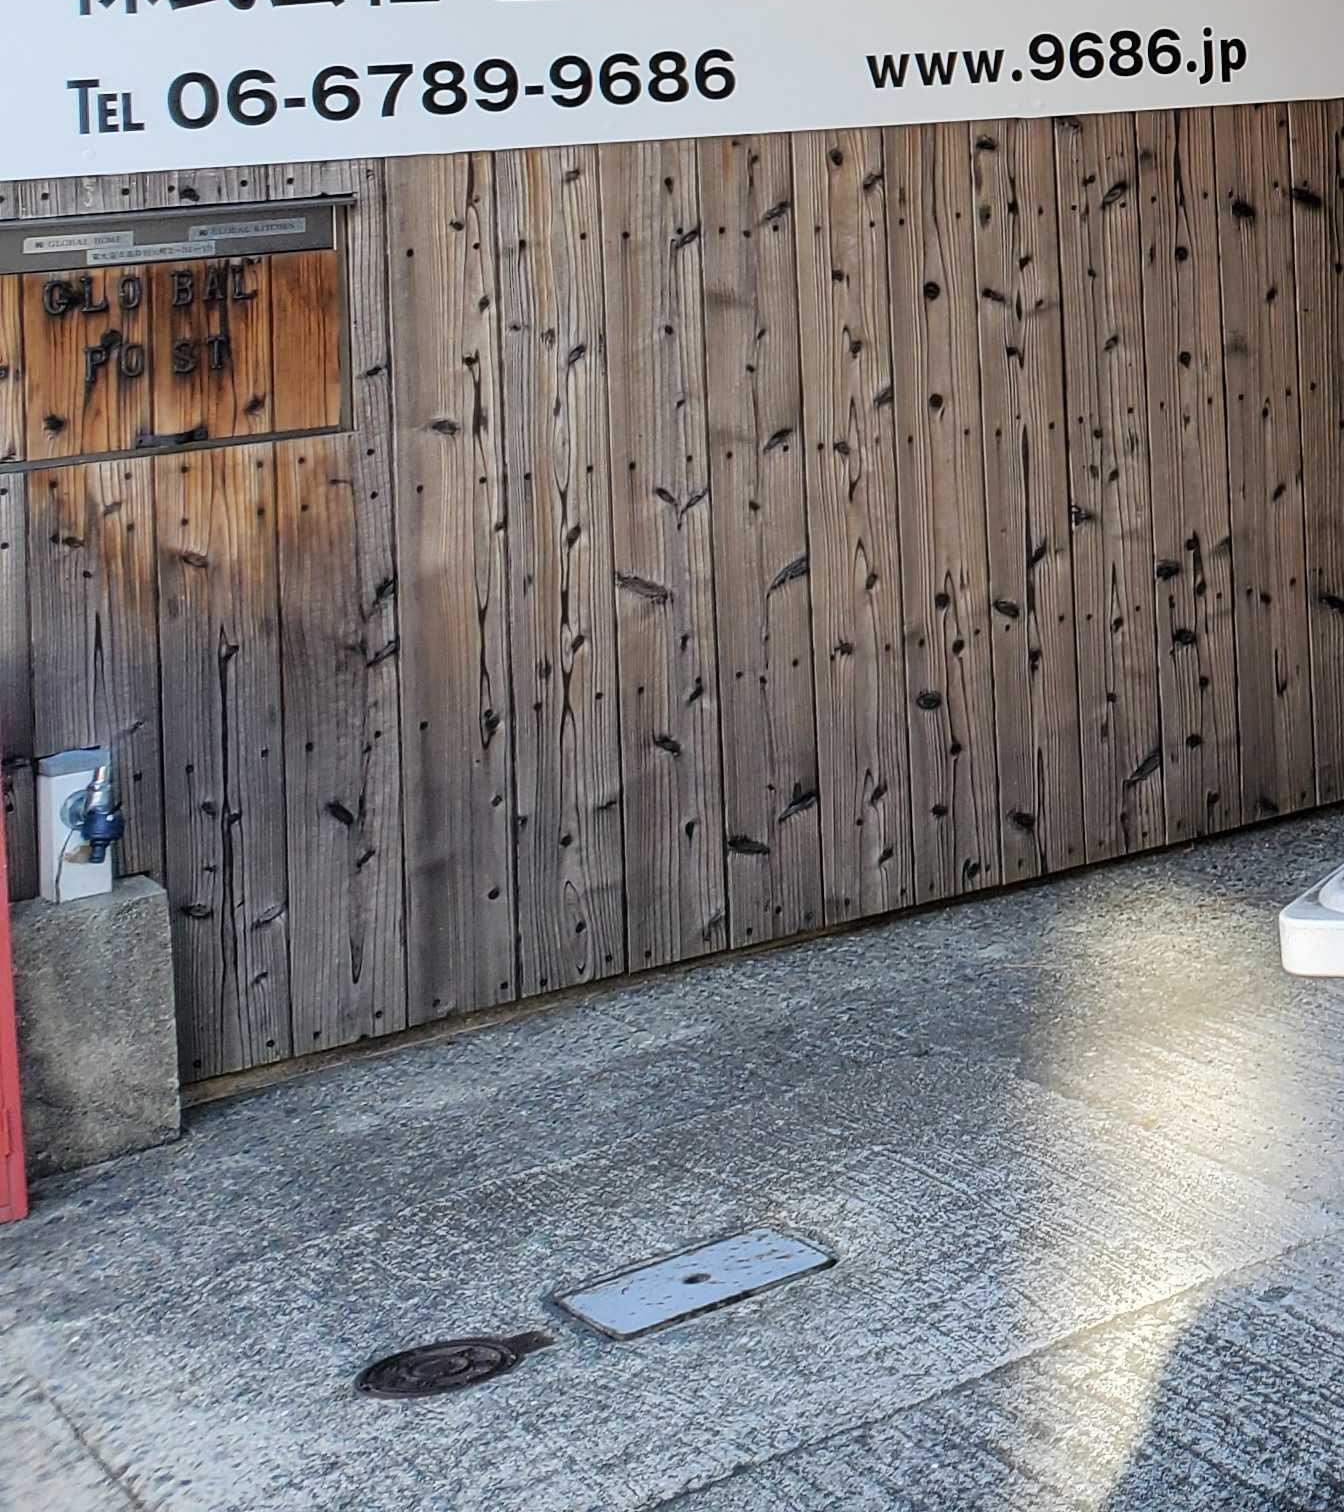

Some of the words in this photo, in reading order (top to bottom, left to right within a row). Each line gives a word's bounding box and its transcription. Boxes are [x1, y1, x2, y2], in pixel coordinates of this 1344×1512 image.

[167, 48, 737, 130] 06-6789-9686
[866, 27, 1248, 90] www.9686.jp
[83, 335, 230, 382] POST
